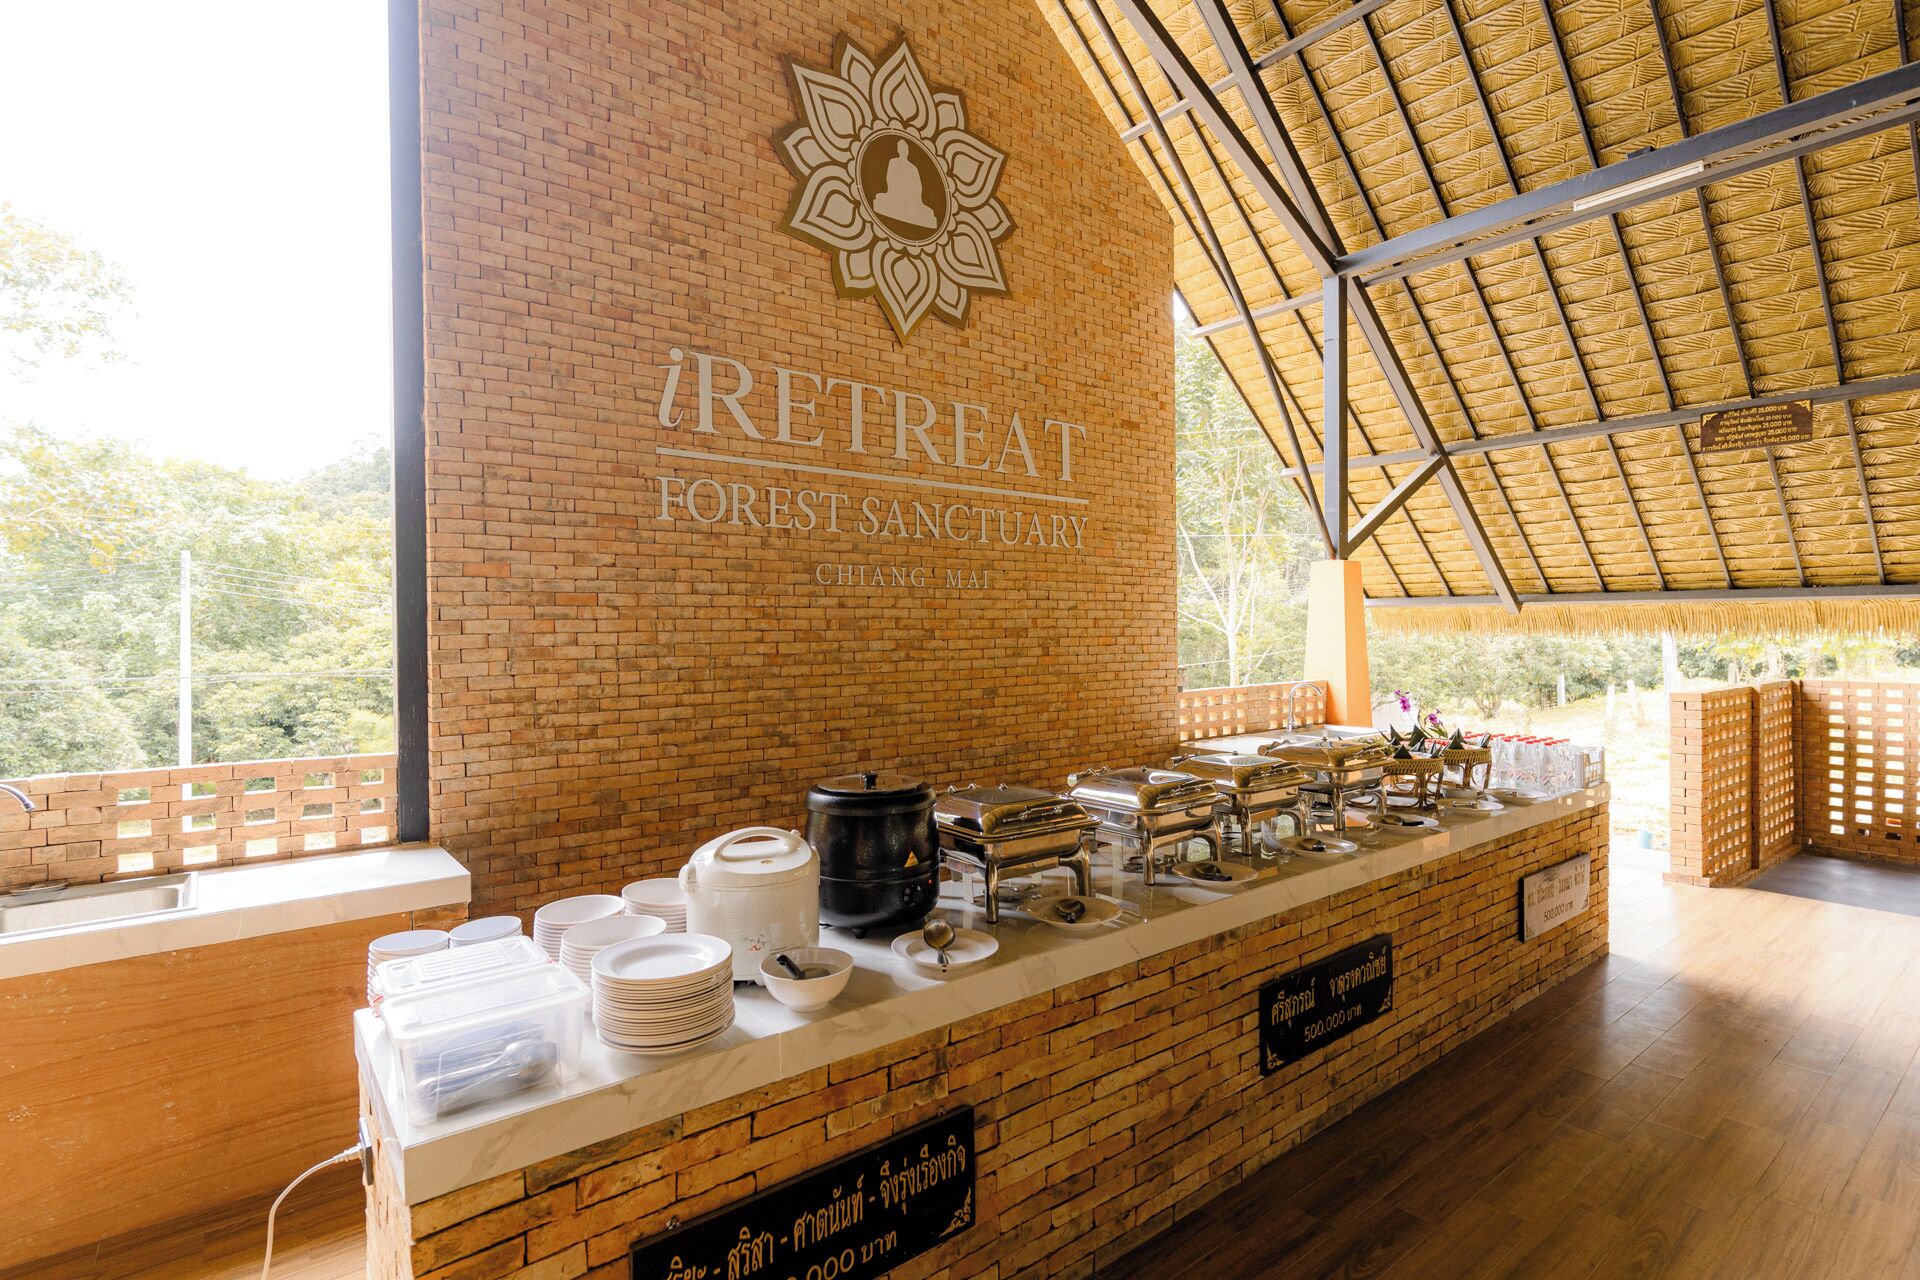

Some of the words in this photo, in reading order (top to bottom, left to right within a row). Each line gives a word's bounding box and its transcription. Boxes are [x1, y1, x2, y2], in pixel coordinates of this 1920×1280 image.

[656, 476, 848, 533] FOREST
[859, 496, 1088, 549] SANCTUARY
[816, 563, 926, 589] CHIANG
[946, 569, 990, 590] MAI
[861, 1230, 897, 1264] บาท
